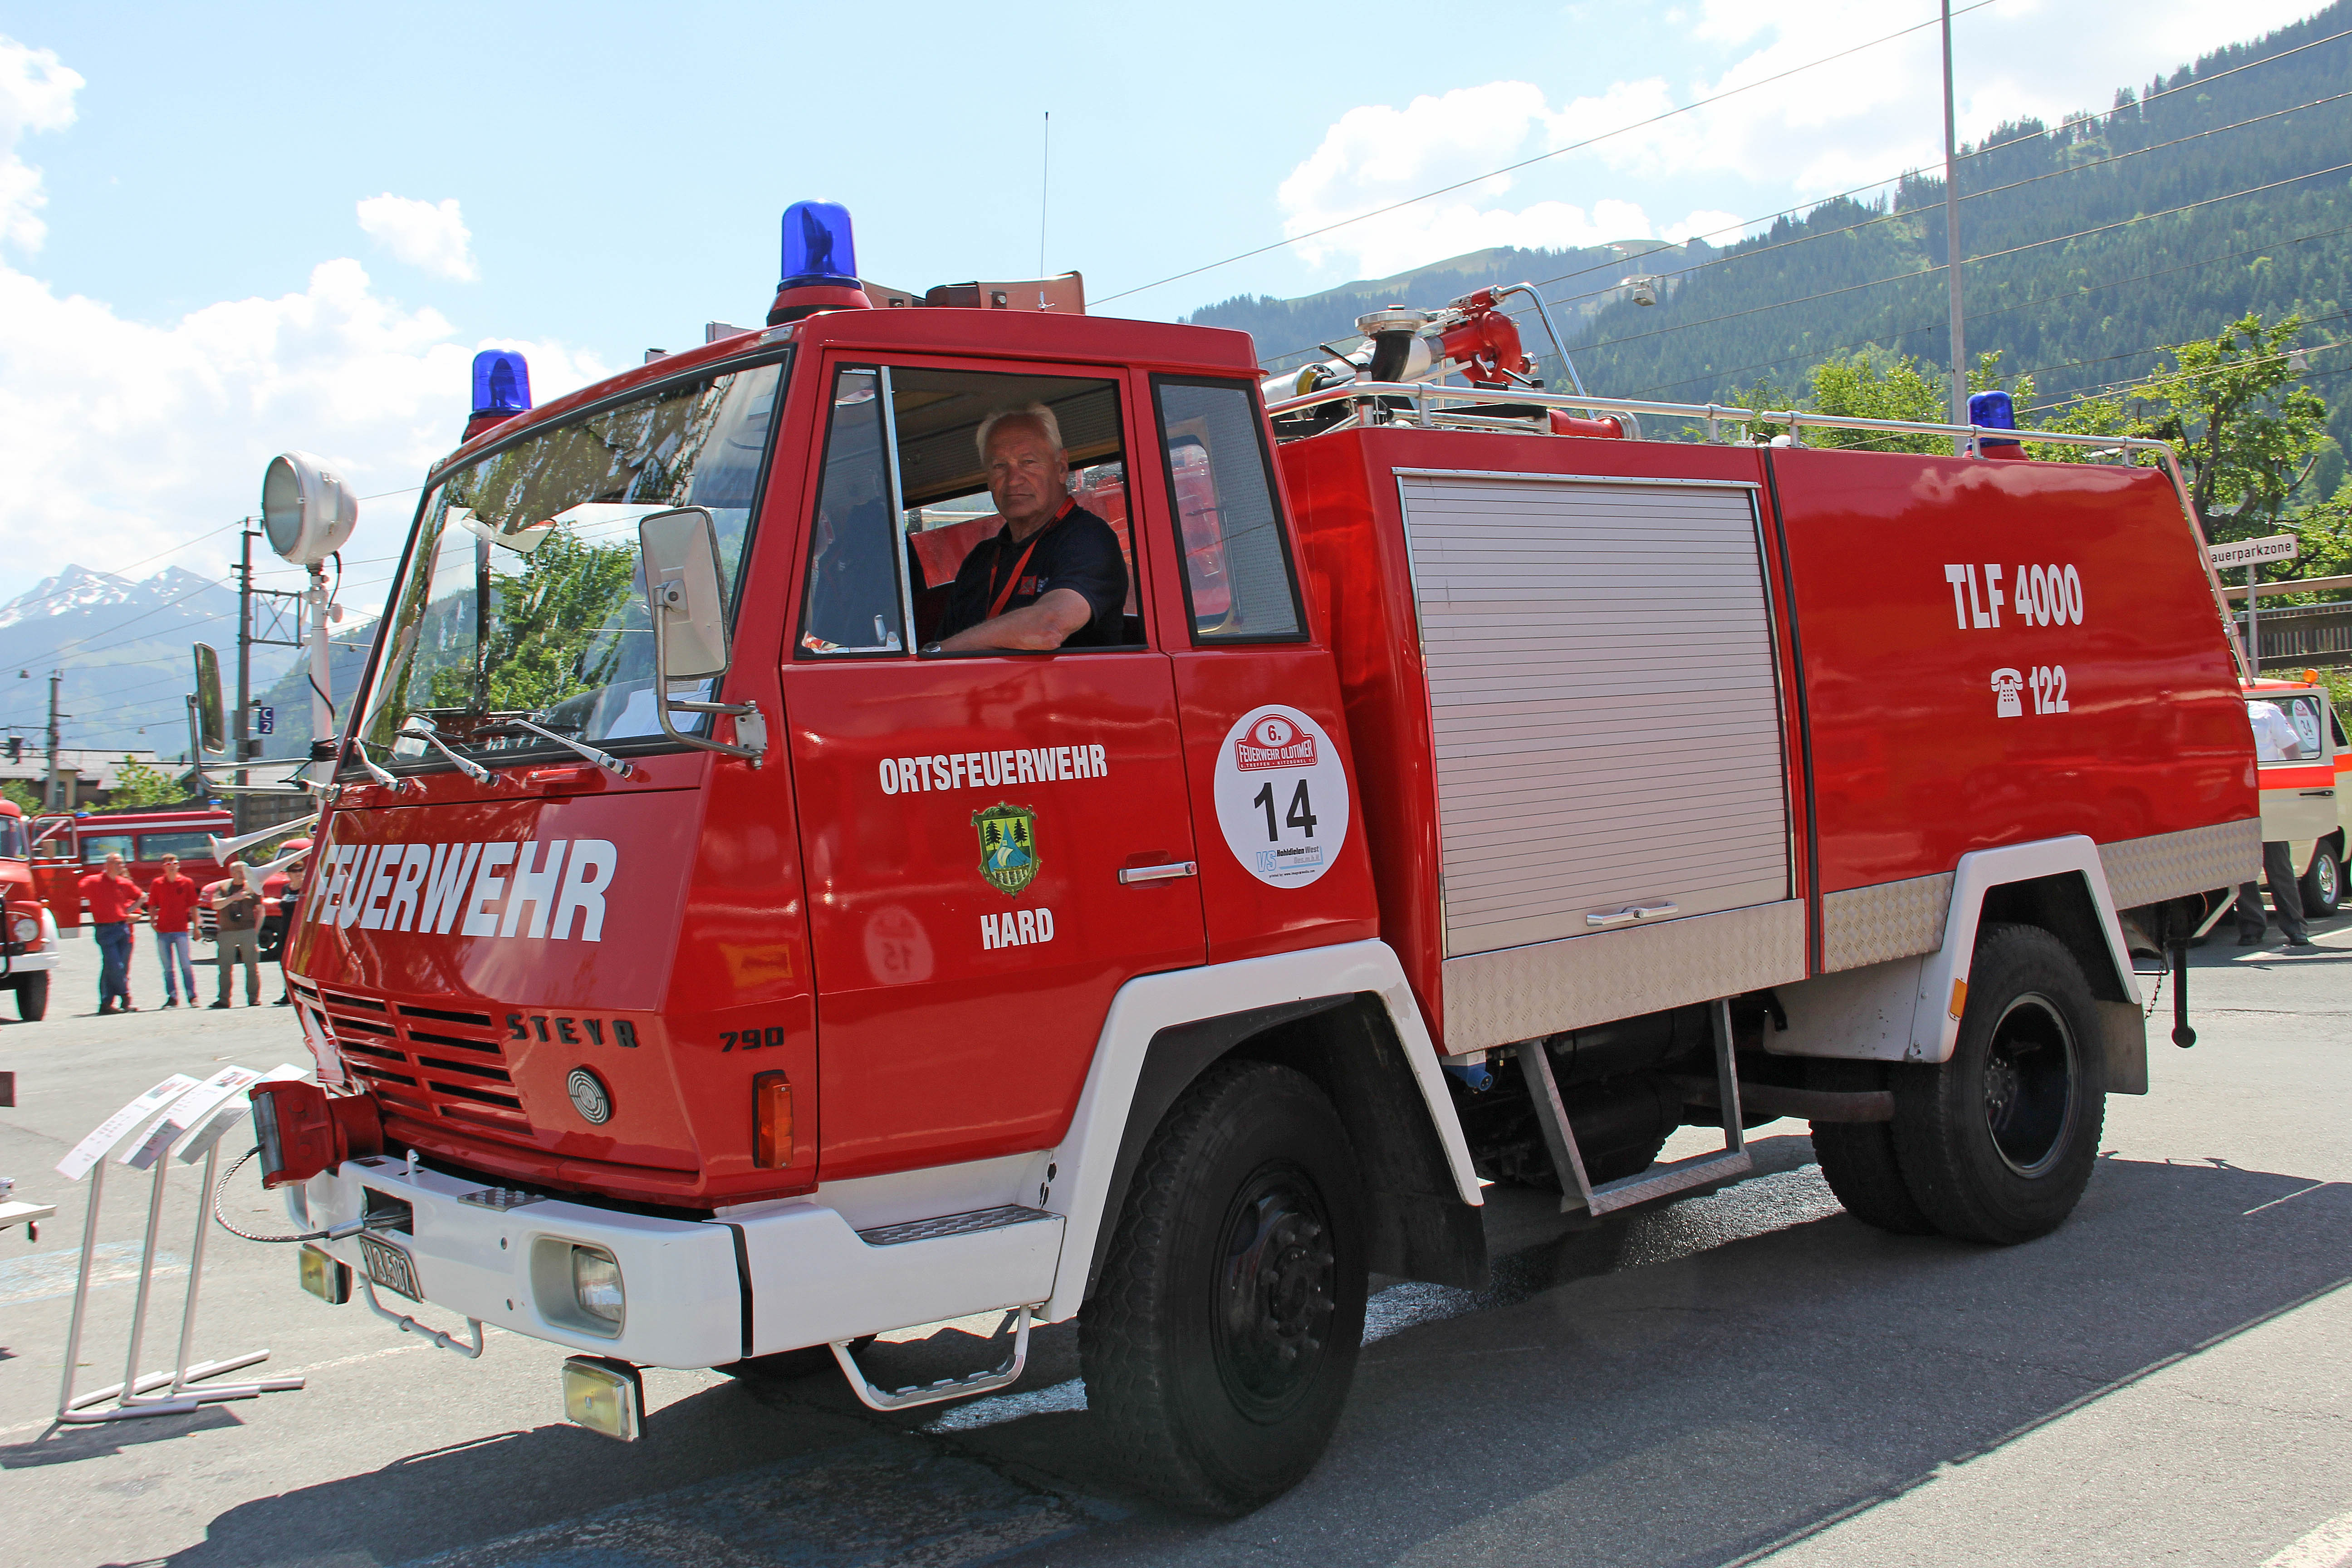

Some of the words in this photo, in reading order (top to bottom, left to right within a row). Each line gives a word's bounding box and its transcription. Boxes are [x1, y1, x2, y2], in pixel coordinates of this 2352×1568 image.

[2211, 543, 2291, 562] auerparkzone
[1944, 564, 2004, 629] TLF
[2014, 564, 2083, 627] 4000
[2029, 665, 2069, 715] 122
[262, 709, 271, 719] C
[263, 722, 271, 732] 2
[1268, 725, 1281, 740] 6.
[1238, 743, 1279, 763] FEUERWEHR
[1281, 739, 1313, 760] OLDTIMER
[879, 744, 1108, 795] ORTSFEUERWEHR
[1254, 779, 1318, 842] 14
[1256, 850, 1277, 872] VS
[1277, 848, 1304, 857] Hohldielen
[306, 839, 617, 942] FEUERWEHR
[980, 908, 1054, 950] HARD
[505, 1014, 639, 1048] STEYR
[720, 1026, 784, 1053] 790
